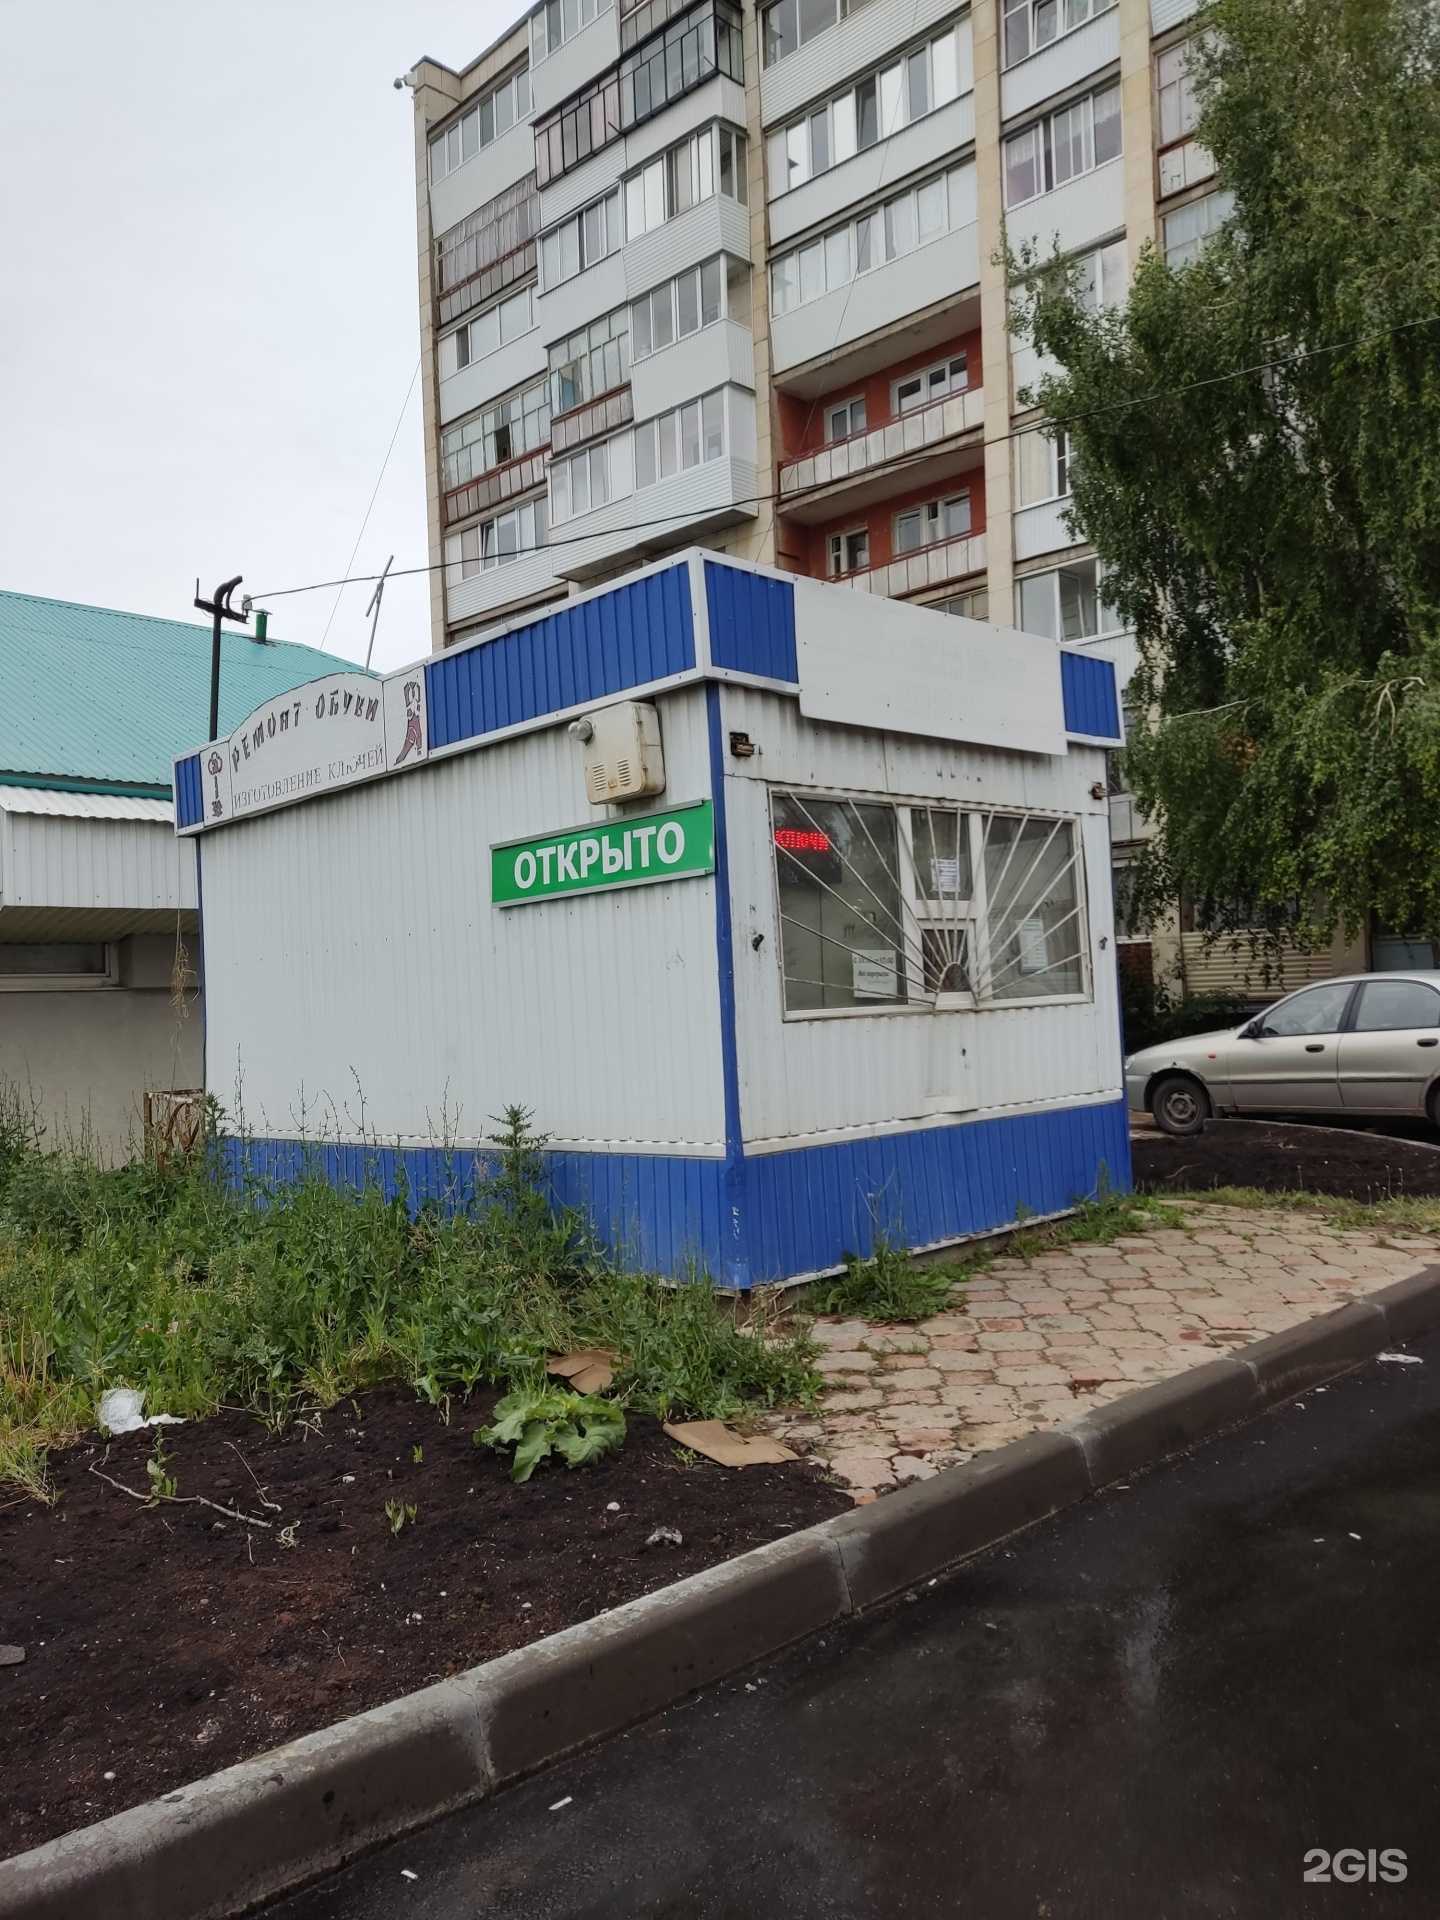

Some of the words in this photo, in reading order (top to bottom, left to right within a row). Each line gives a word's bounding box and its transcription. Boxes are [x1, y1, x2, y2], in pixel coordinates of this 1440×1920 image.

[231, 701, 302, 773] РЕМОНТ
[315, 687, 380, 722] ОБУВИ
[233, 767, 321, 810] ИЗГОТОВЛЕНИЕ
[513, 820, 686, 890] ОТКРЫТО
